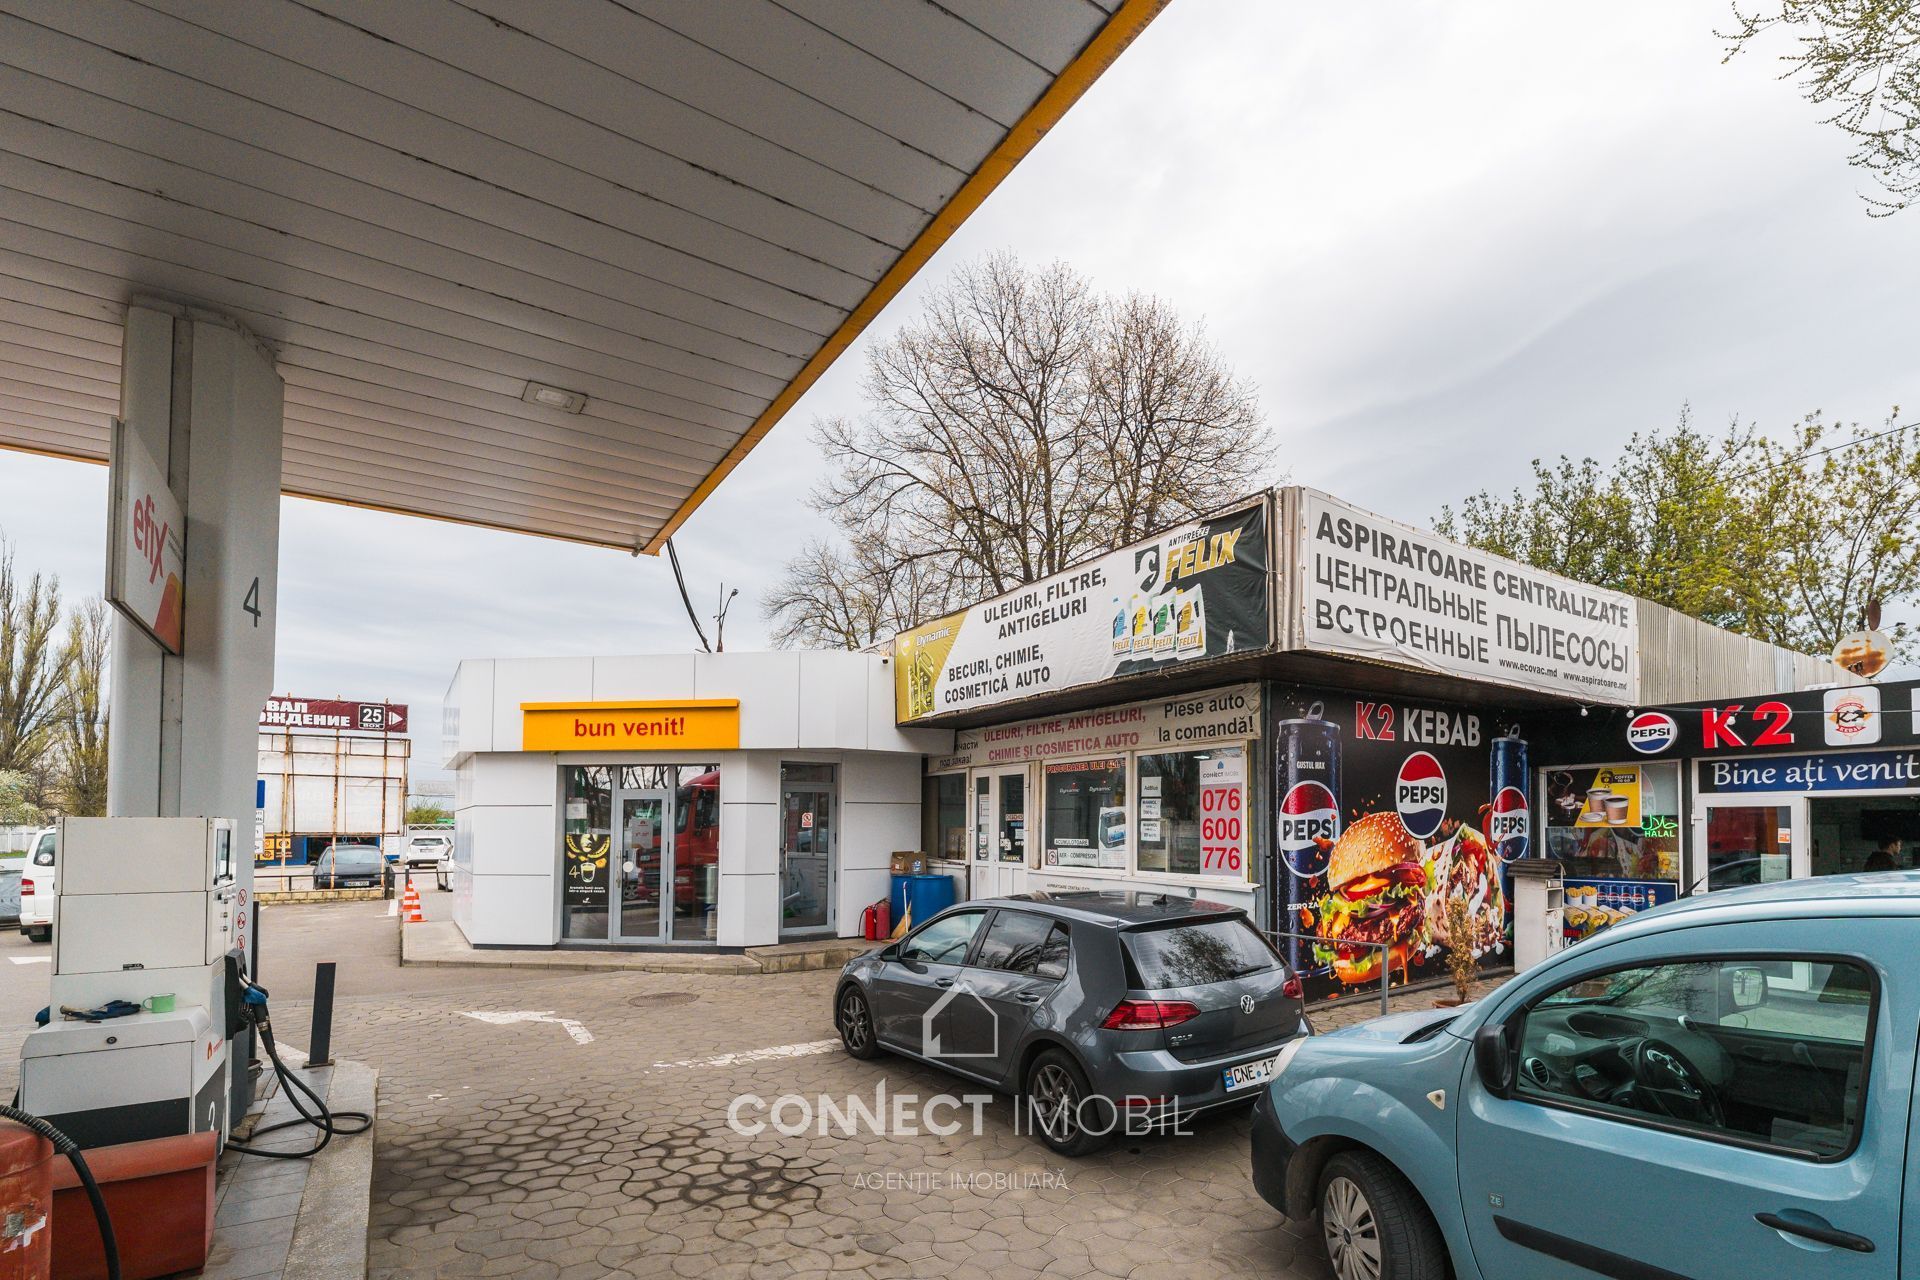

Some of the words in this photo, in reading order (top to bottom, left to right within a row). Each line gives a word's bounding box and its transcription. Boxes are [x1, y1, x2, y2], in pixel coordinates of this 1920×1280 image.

[133, 494, 168, 585] efix
[1167, 525, 1211, 548] ANTIFREEZE
[1164, 527, 1243, 583] FELIX
[1315, 511, 1487, 590] ASPIRATOARE
[1493, 570, 1629, 629] CENTRALIZATE
[242, 576, 262, 628] 4
[984, 591, 1042, 624] ULEIURI,
[1046, 568, 1107, 602] FILTRE,
[1315, 552, 1488, 627] ЦЕНТРАЛЬНЫЕ
[998, 596, 1087, 640] ANTIGELURI
[1315, 598, 1489, 664] ВСТРОЕННЫЕ
[1155, 636, 1173, 648] FELIX
[1178, 635, 1198, 648] FELIX
[1496, 613, 1628, 674] ПЫЛЕСОСЫ
[949, 659, 992, 682] BECURI,
[995, 644, 1044, 670] CHIMIE,
[1498, 658, 1558, 678] www.ecovac.md
[1563, 671, 1627, 691] www.aspiratoare.md
[944, 673, 1009, 704] COSMETICĂ
[1015, 666, 1051, 689] AUTO
[362, 707, 382, 723] 25
[1164, 701, 1204, 718] Piese
[1209, 695, 1245, 712] auto
[574, 719, 615, 737] bun
[623, 717, 685, 736] venit!
[984, 727, 1024, 743] ULEIURI,
[1026, 720, 1064, 737] FILTRE,
[1068, 707, 1146, 732] ANTIGELURI,
[1158, 726, 1170, 742] la
[1175, 715, 1254, 740] comandă!
[1355, 701, 1395, 742] K2
[1403, 707, 1481, 747] KEBAB
[1631, 726, 1671, 739] PEPSI
[1702, 701, 1795, 749] K2
[988, 749, 1021, 761] CHIMIE
[1104, 732, 1140, 748] AUTO
[1713, 762, 1775, 787] Bine
[1785, 758, 1827, 791] ați
[1202, 788, 1241, 812] 076
[1399, 785, 1444, 804] PEPSI
[1202, 817, 1241, 841] 600
[1282, 816, 1338, 841] PEPSI
[1493, 816, 1527, 834] PEPSI
[1640, 813, 1678, 831] حلال
[1644, 830, 1676, 838] HALAL
[1202, 846, 1241, 871] 776
[1287, 902, 1308, 911] ZERO
[1233, 1064, 1256, 1084] CNE
